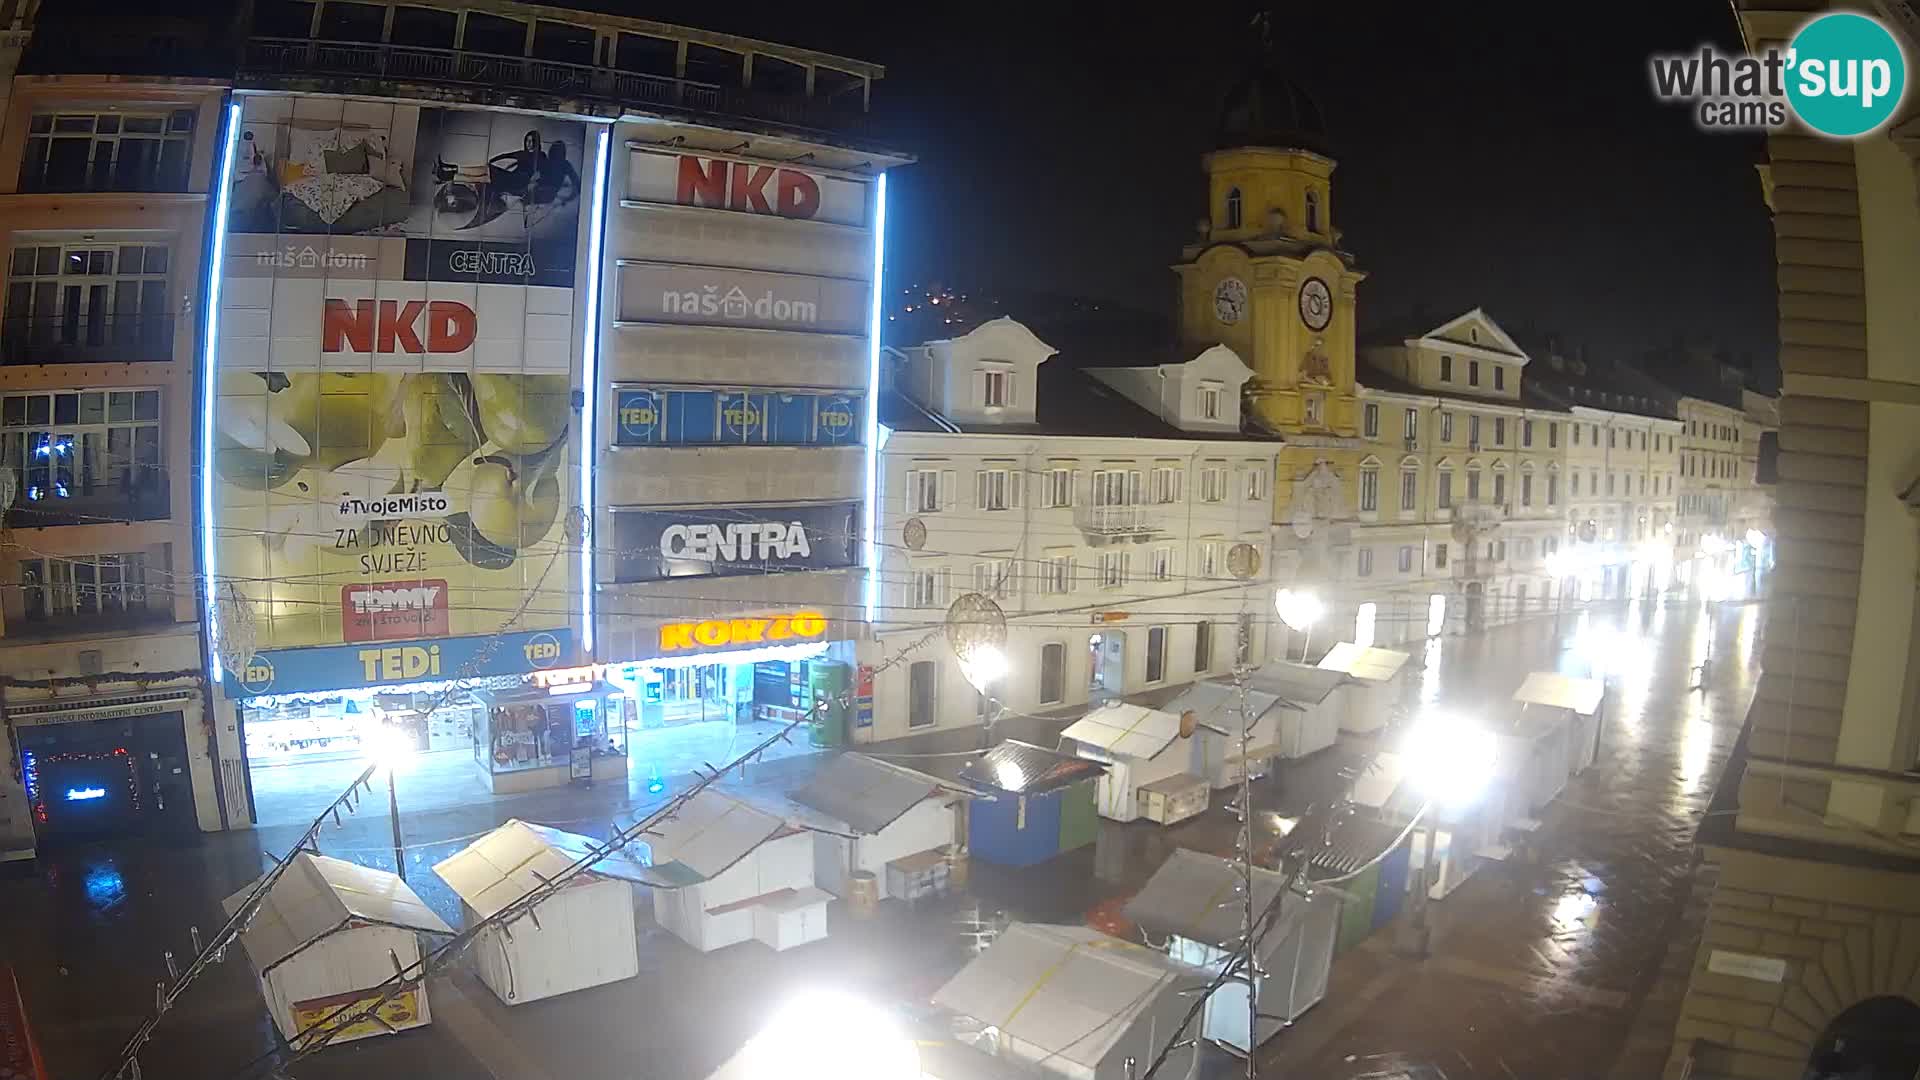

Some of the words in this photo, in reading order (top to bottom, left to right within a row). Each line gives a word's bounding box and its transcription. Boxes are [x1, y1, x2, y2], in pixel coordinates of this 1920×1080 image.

[676, 155, 820, 219] NKD
[256, 245, 297, 270] naš
[321, 248, 367, 271] dom
[450, 250, 536, 276] CENTRA
[662, 284, 719, 317] naš
[754, 290, 817, 323] dom
[322, 297, 478, 354] NKD
[620, 407, 659, 426] TEDi
[723, 408, 761, 427] TEDi
[820, 411, 854, 427] TEDi
[340, 496, 448, 517] #TvojeMisto
[335, 528, 359, 549] ZA
[367, 522, 452, 549] DNEVNO
[660, 521, 811, 562] CENTRA
[360, 546, 428, 575] SVJEŽE
[350, 585, 441, 614] TOMMY
[360, 645, 441, 682] TEDi
[524, 642, 561, 659] TEDi
